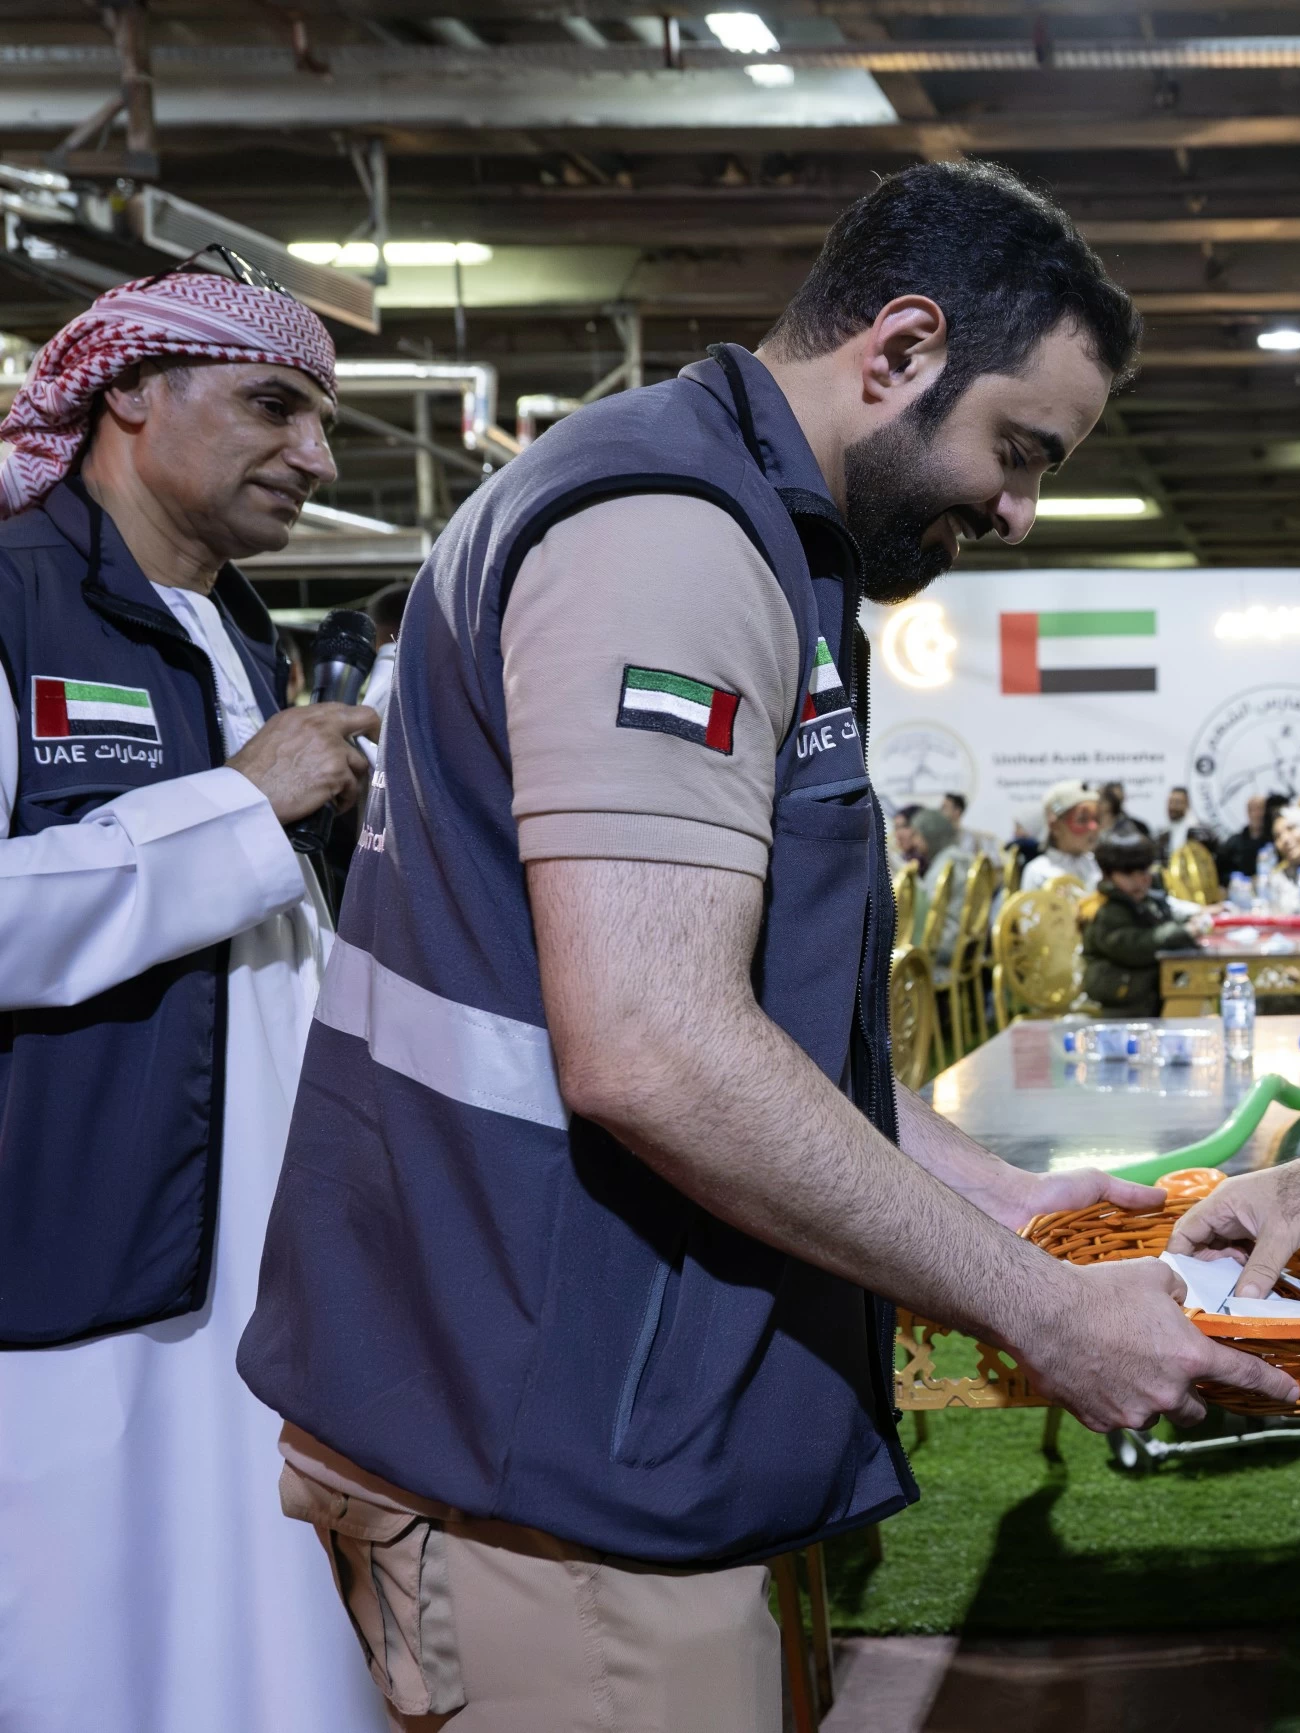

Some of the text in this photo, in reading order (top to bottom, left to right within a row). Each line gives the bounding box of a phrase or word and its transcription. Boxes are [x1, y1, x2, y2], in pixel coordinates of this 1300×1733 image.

[34, 743, 163, 769] UAE الإمارات
[796, 725, 837, 759] UAE
